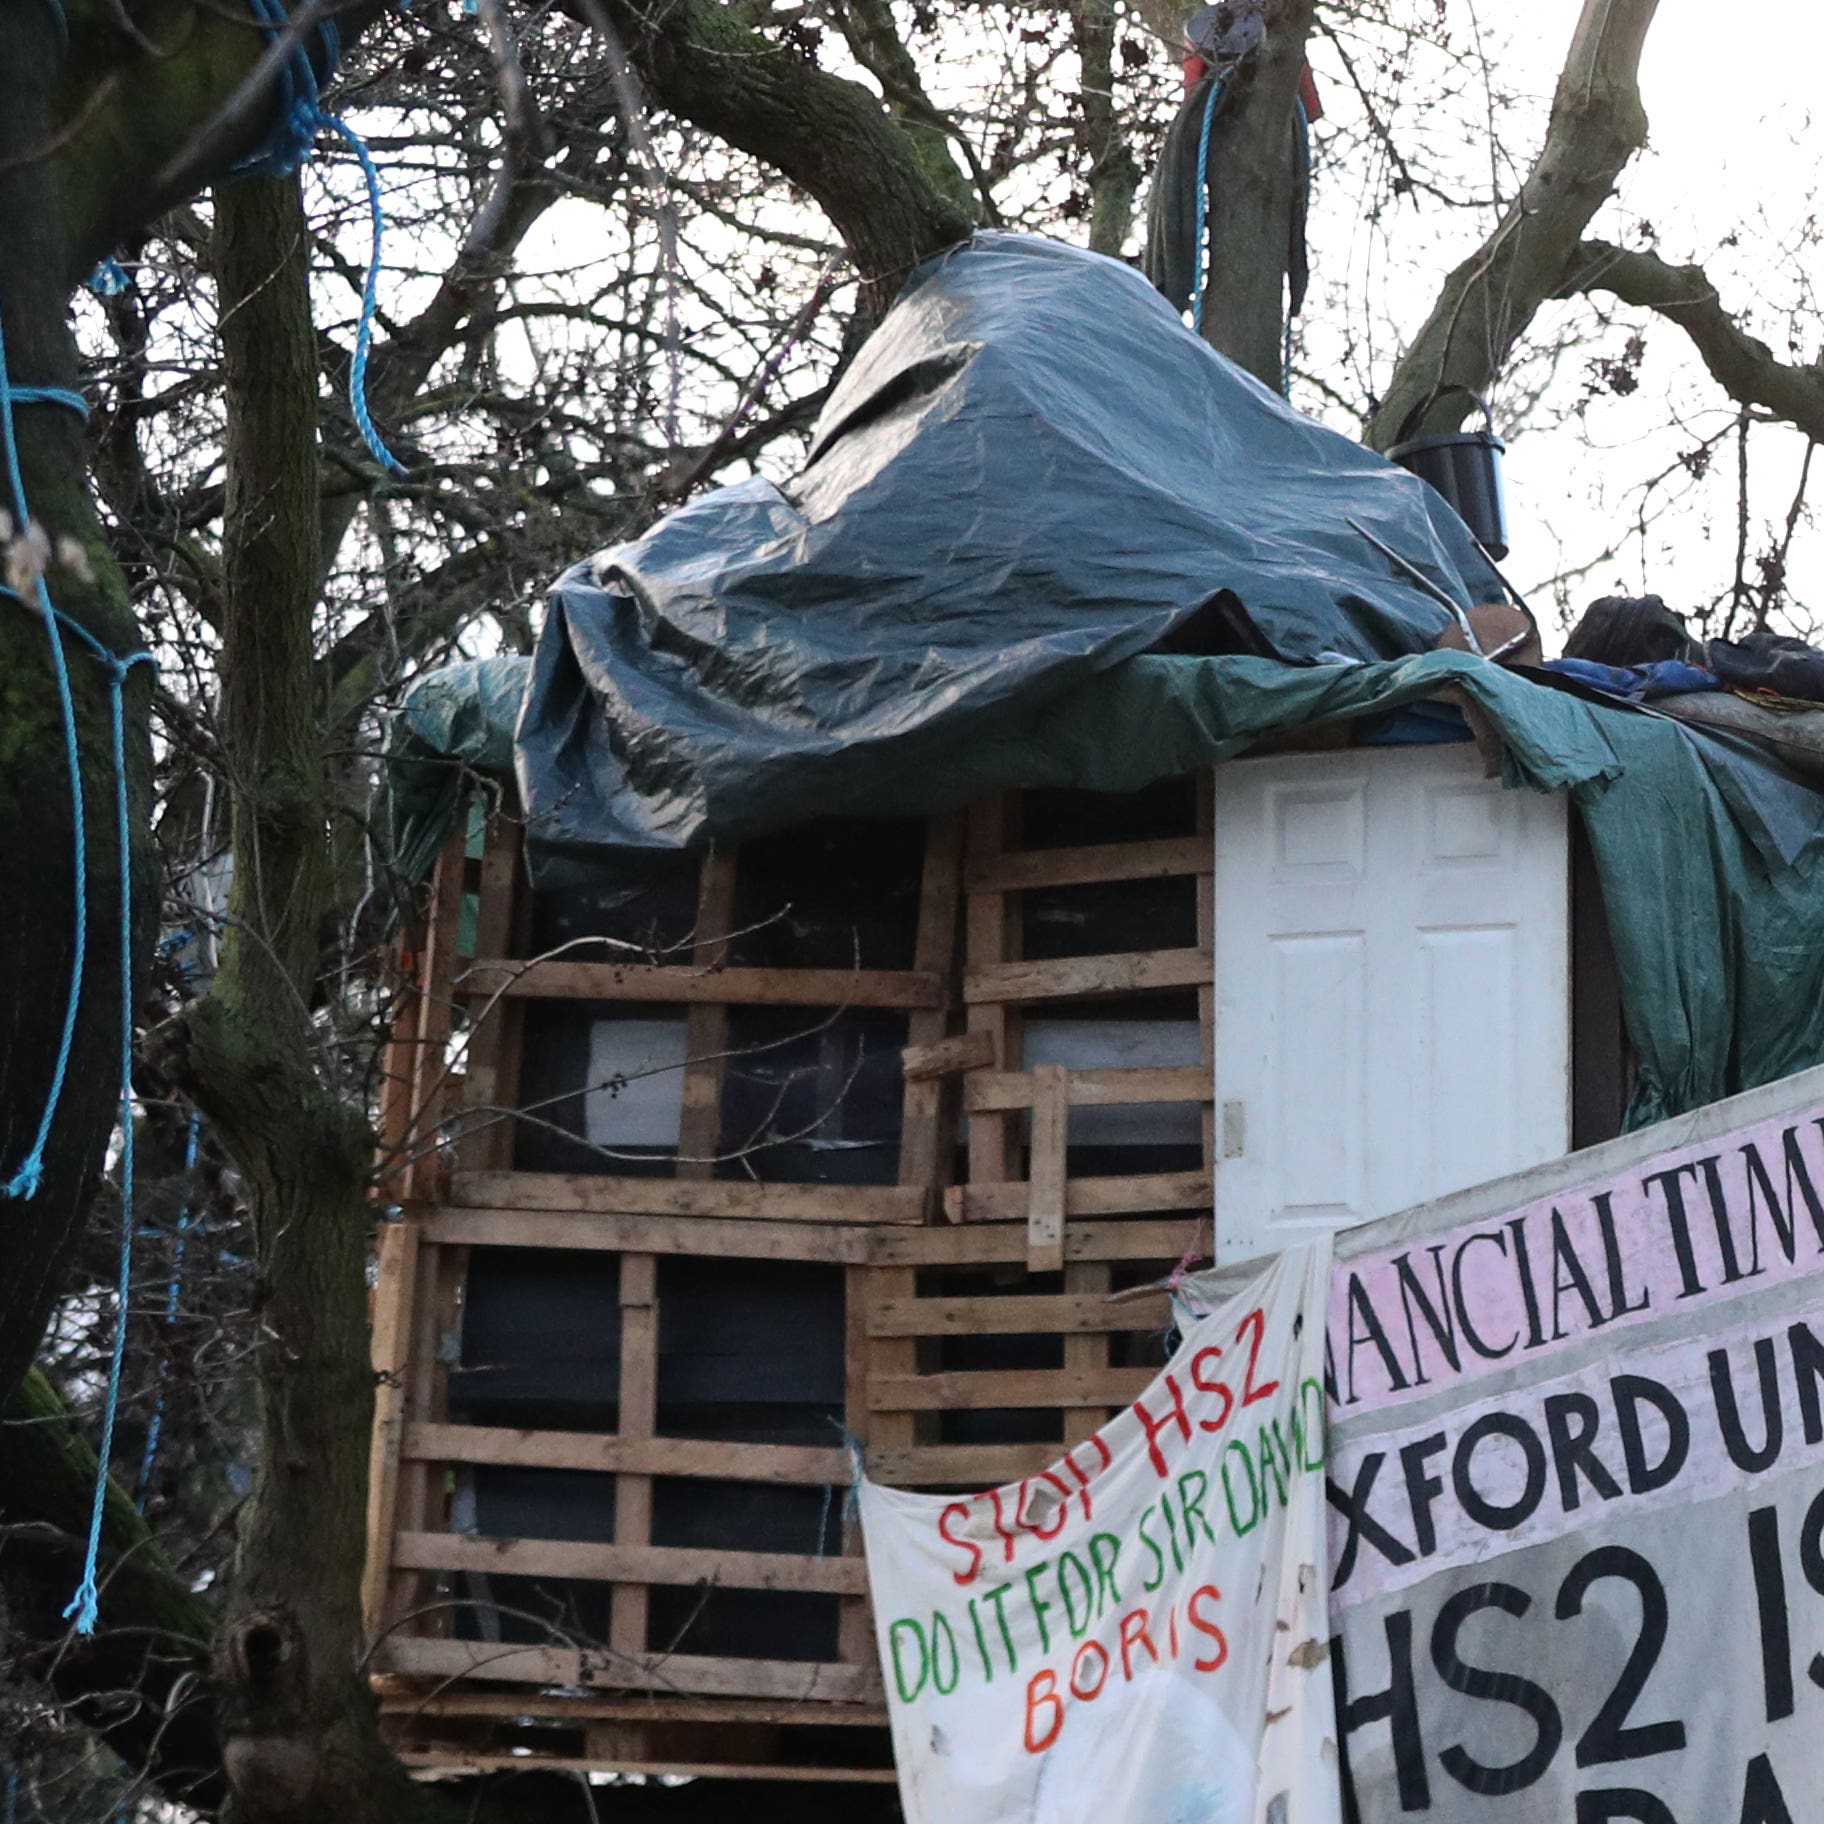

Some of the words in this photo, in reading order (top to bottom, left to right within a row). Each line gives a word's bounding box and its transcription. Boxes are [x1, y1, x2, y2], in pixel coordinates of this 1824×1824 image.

[1325, 1190, 1650, 1408] ANCIAL
[938, 1435, 1112, 1585] STOP
[1134, 1308, 1279, 1478] HS2
[889, 1611, 959, 1703] DO
[968, 1582, 1017, 1683] IT
[1023, 1533, 1122, 1655] FOR
[1138, 1469, 1216, 1593] SIR
[1023, 1585, 1229, 1753] BORIS
